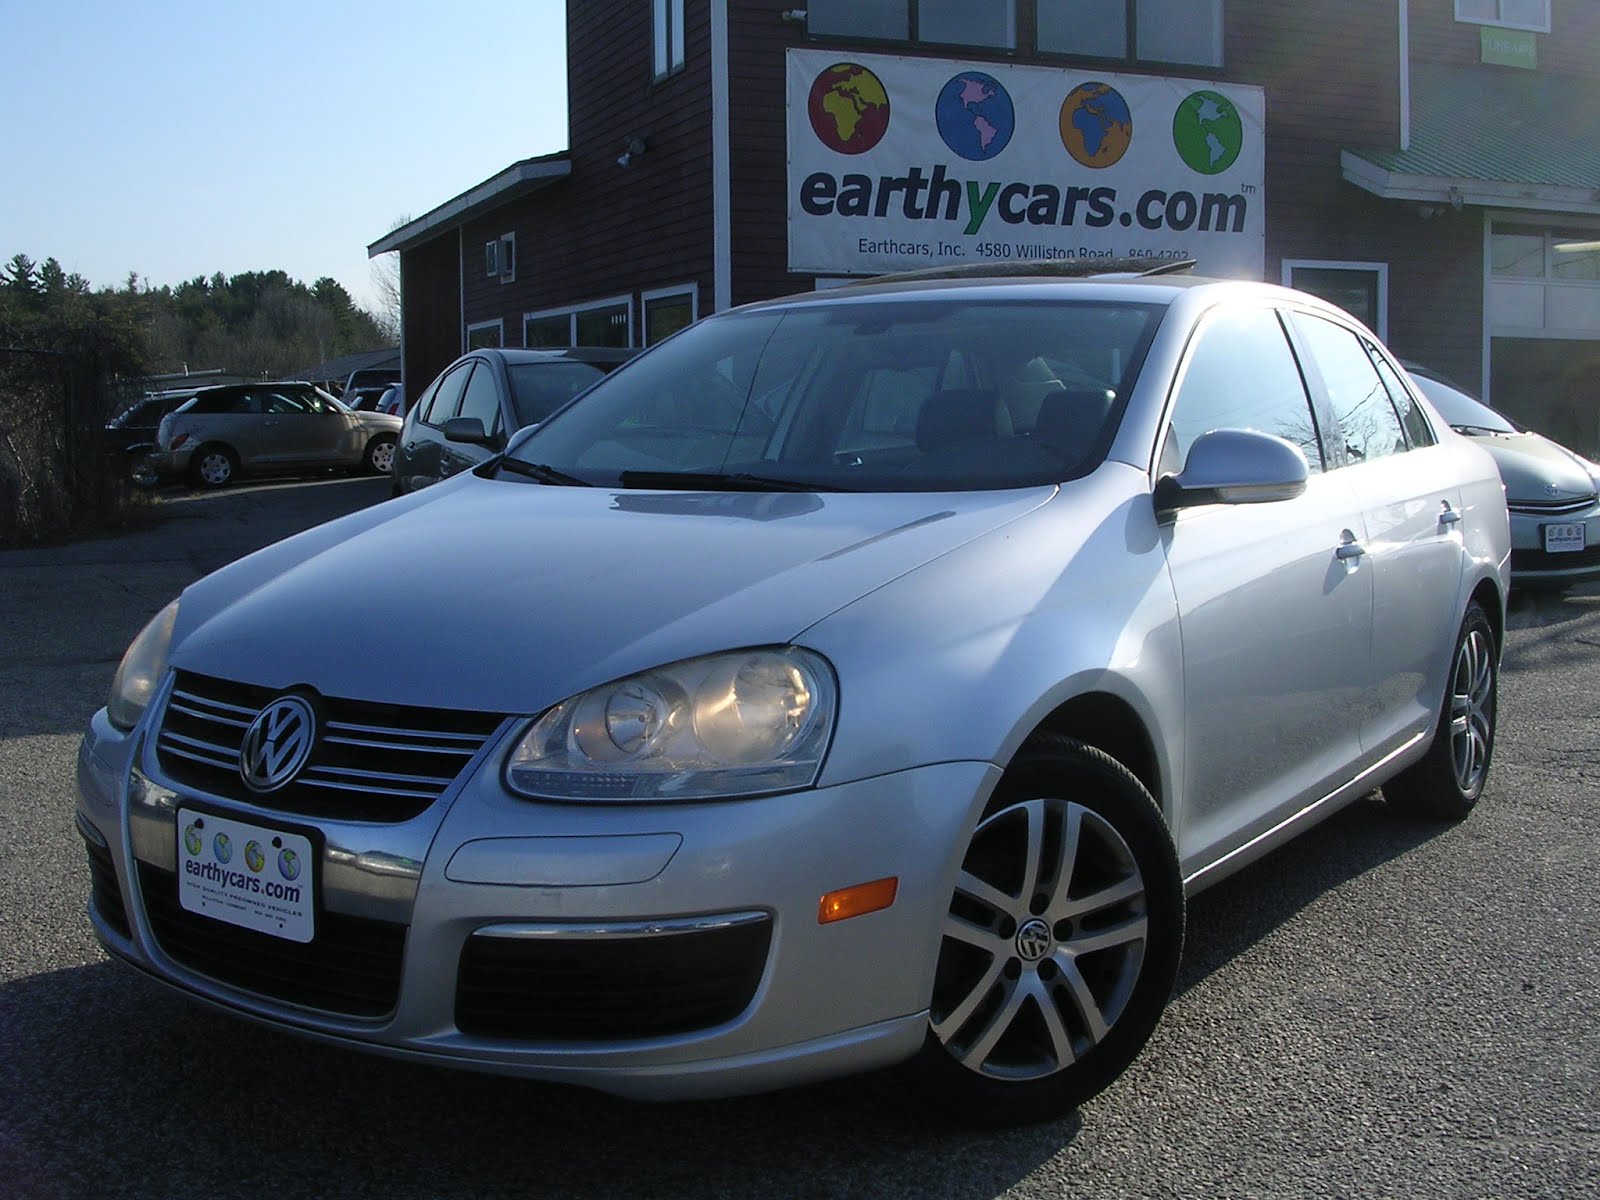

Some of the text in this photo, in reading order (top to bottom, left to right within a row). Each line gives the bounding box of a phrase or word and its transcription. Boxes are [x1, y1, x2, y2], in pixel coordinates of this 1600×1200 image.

[800, 165, 1248, 235] earthycars.com
[858, 238, 934, 258] Earthcars,
[937, 241, 966, 256] Inc.
[975, 242, 1011, 257] 4580
[1016, 244, 1075, 260] Williston
[1079, 246, 1113, 258] Road
[185, 859, 300, 903] earthycars.com
